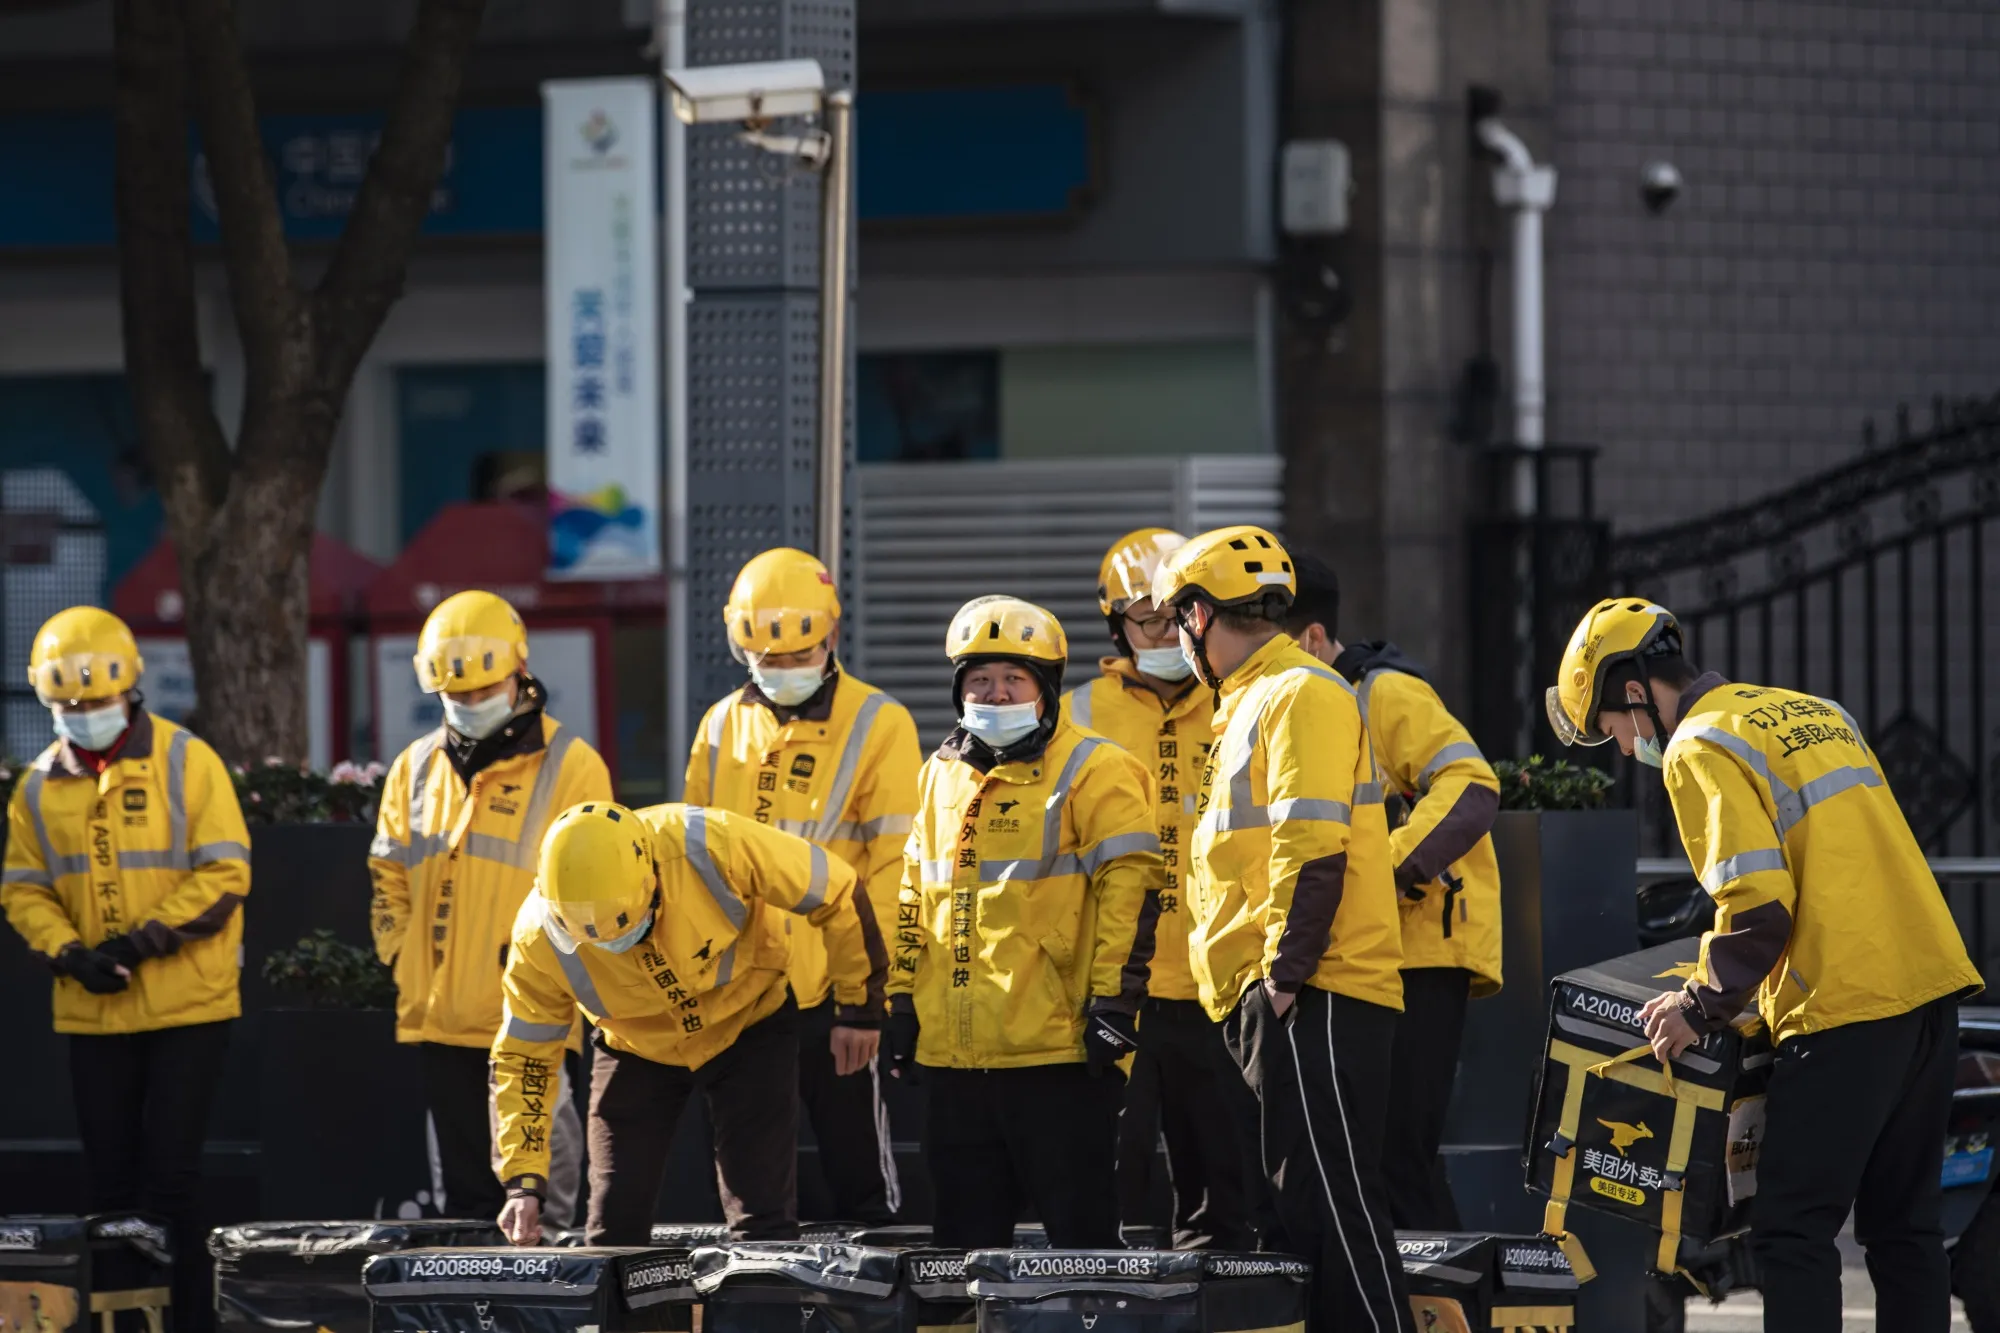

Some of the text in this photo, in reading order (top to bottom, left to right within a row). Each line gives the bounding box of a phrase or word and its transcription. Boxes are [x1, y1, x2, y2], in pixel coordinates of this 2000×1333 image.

[1743, 698, 1835, 730] 订火车票
[1776, 723, 1857, 759] 上美团App
[1158, 720, 1180, 804] 美团外卖
[988, 818, 1020, 829] 美团外卖
[952, 783, 989, 988] 团外卖 买菜也快
[1583, 1148, 1660, 1191] 美团外卖
[1598, 1180, 1638, 1203] 美团专送
[411, 1259, 548, 1276] A2008899-064
[1017, 1257, 1151, 1276] A2008899-083
[1214, 1261, 1303, 1276] A2008899-083
